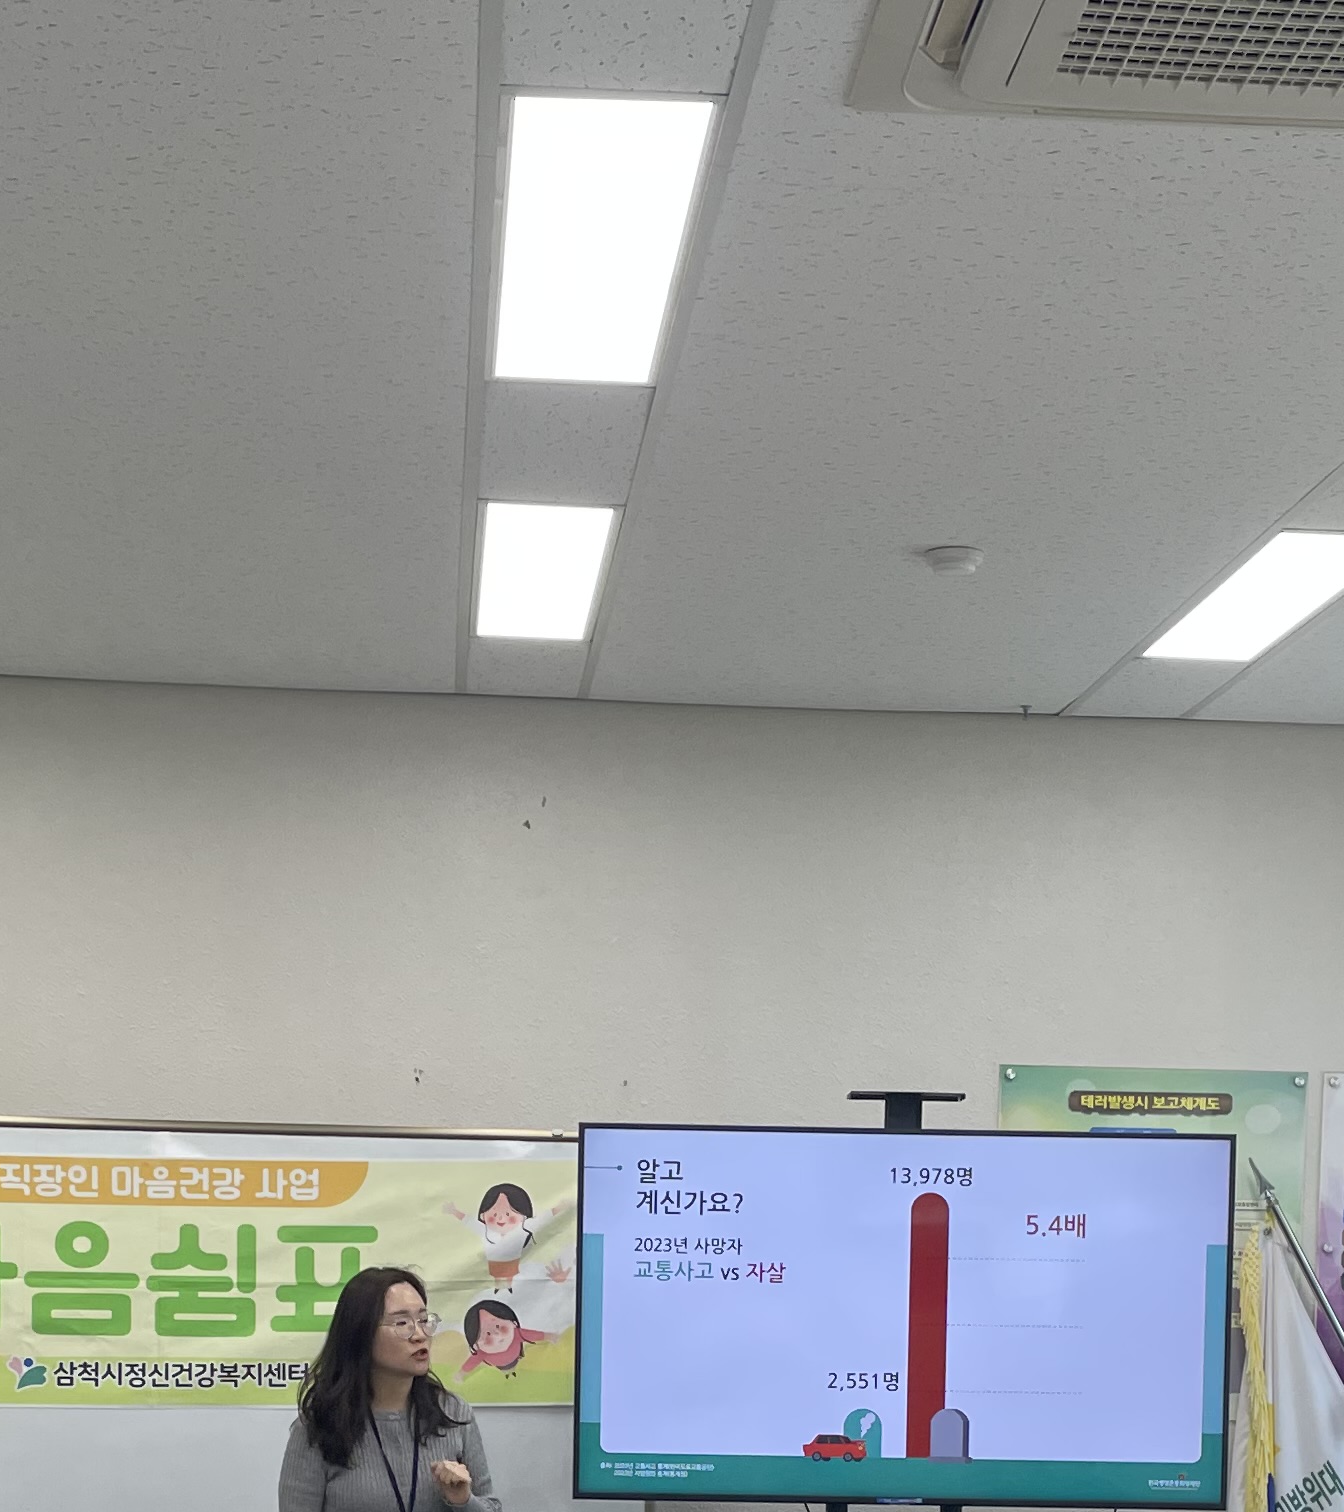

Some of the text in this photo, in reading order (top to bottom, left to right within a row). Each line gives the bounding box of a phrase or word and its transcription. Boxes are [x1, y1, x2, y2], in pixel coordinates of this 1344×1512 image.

[1080, 1094, 1221, 1111] 테러발생시 보고체계도
[110, 1164, 245, 1201] 마음건강
[255, 1166, 322, 1202] 사업
[636, 1158, 684, 1184] 알고
[889, 1166, 974, 1189] 13,978명
[636, 1189, 744, 1216] 계신가요?
[1025, 1212, 1088, 1240] 5.4배
[634, 1236, 743, 1256] 2023년 사망자
[633, 1260, 786, 1285] 교통사고 vs 자살
[53, 1361, 310, 1389] 삼척시정신건강복지센터
[827, 1370, 901, 1393] 2,551명
